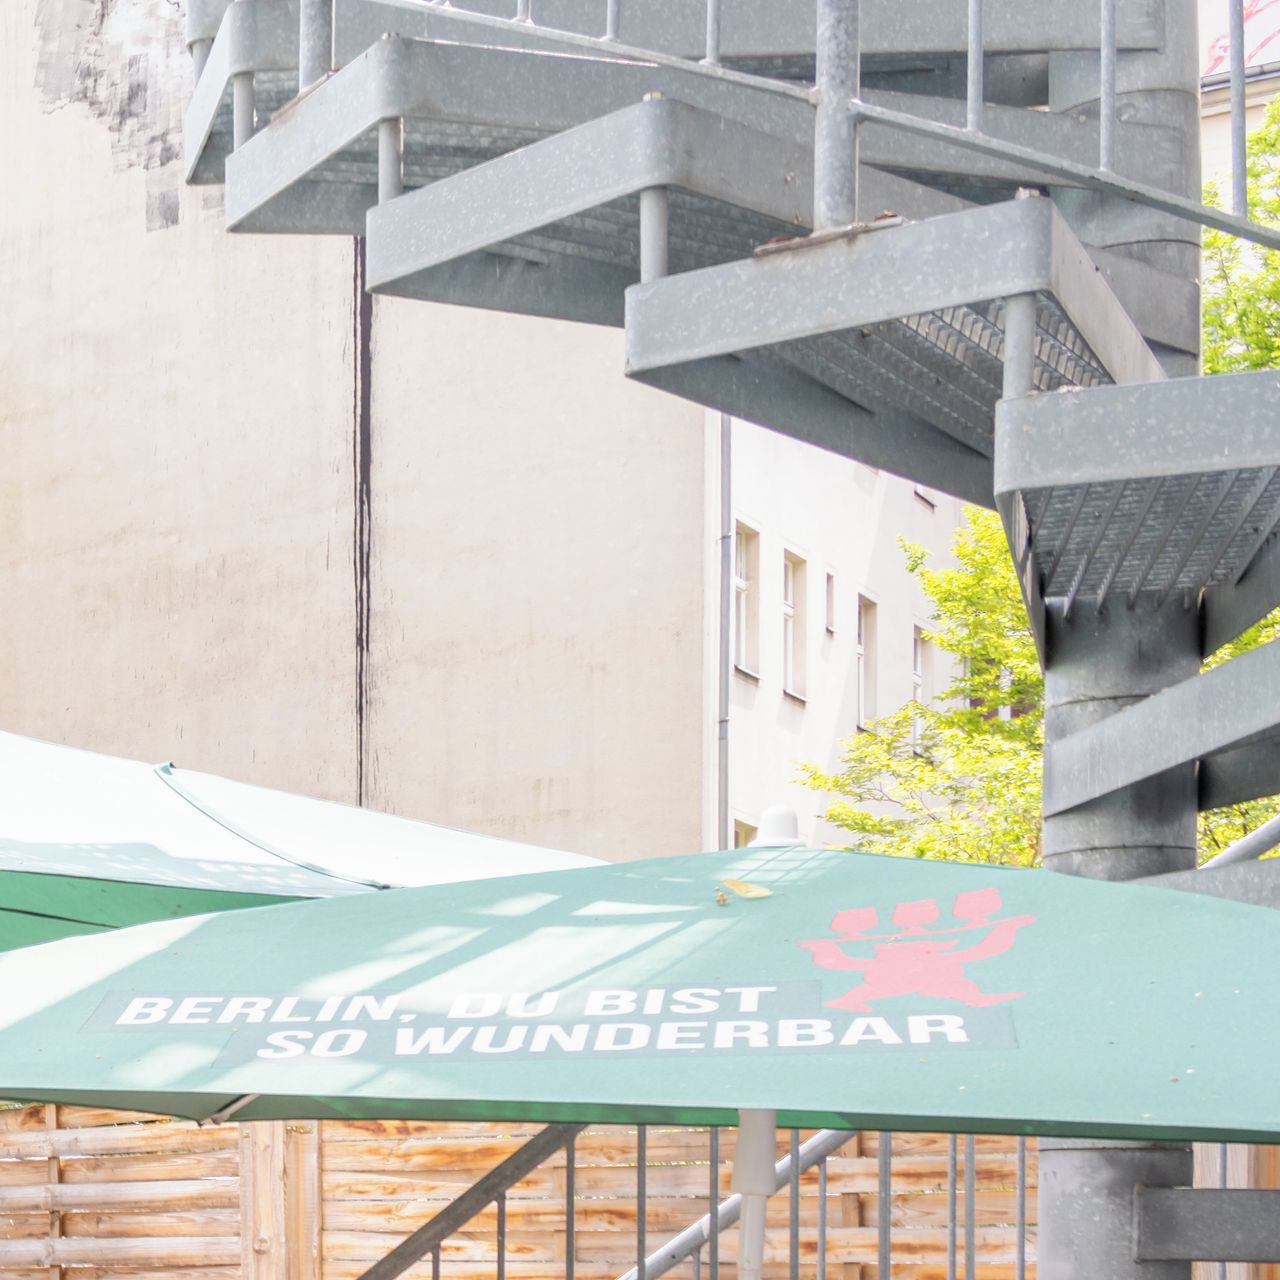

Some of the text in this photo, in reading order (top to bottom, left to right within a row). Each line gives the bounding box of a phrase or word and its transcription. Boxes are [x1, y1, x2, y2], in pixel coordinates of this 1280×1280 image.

[114, 985, 778, 1025] BERLIN, DU BIST
[255, 1013, 970, 1059] SO WUNDERBAR
